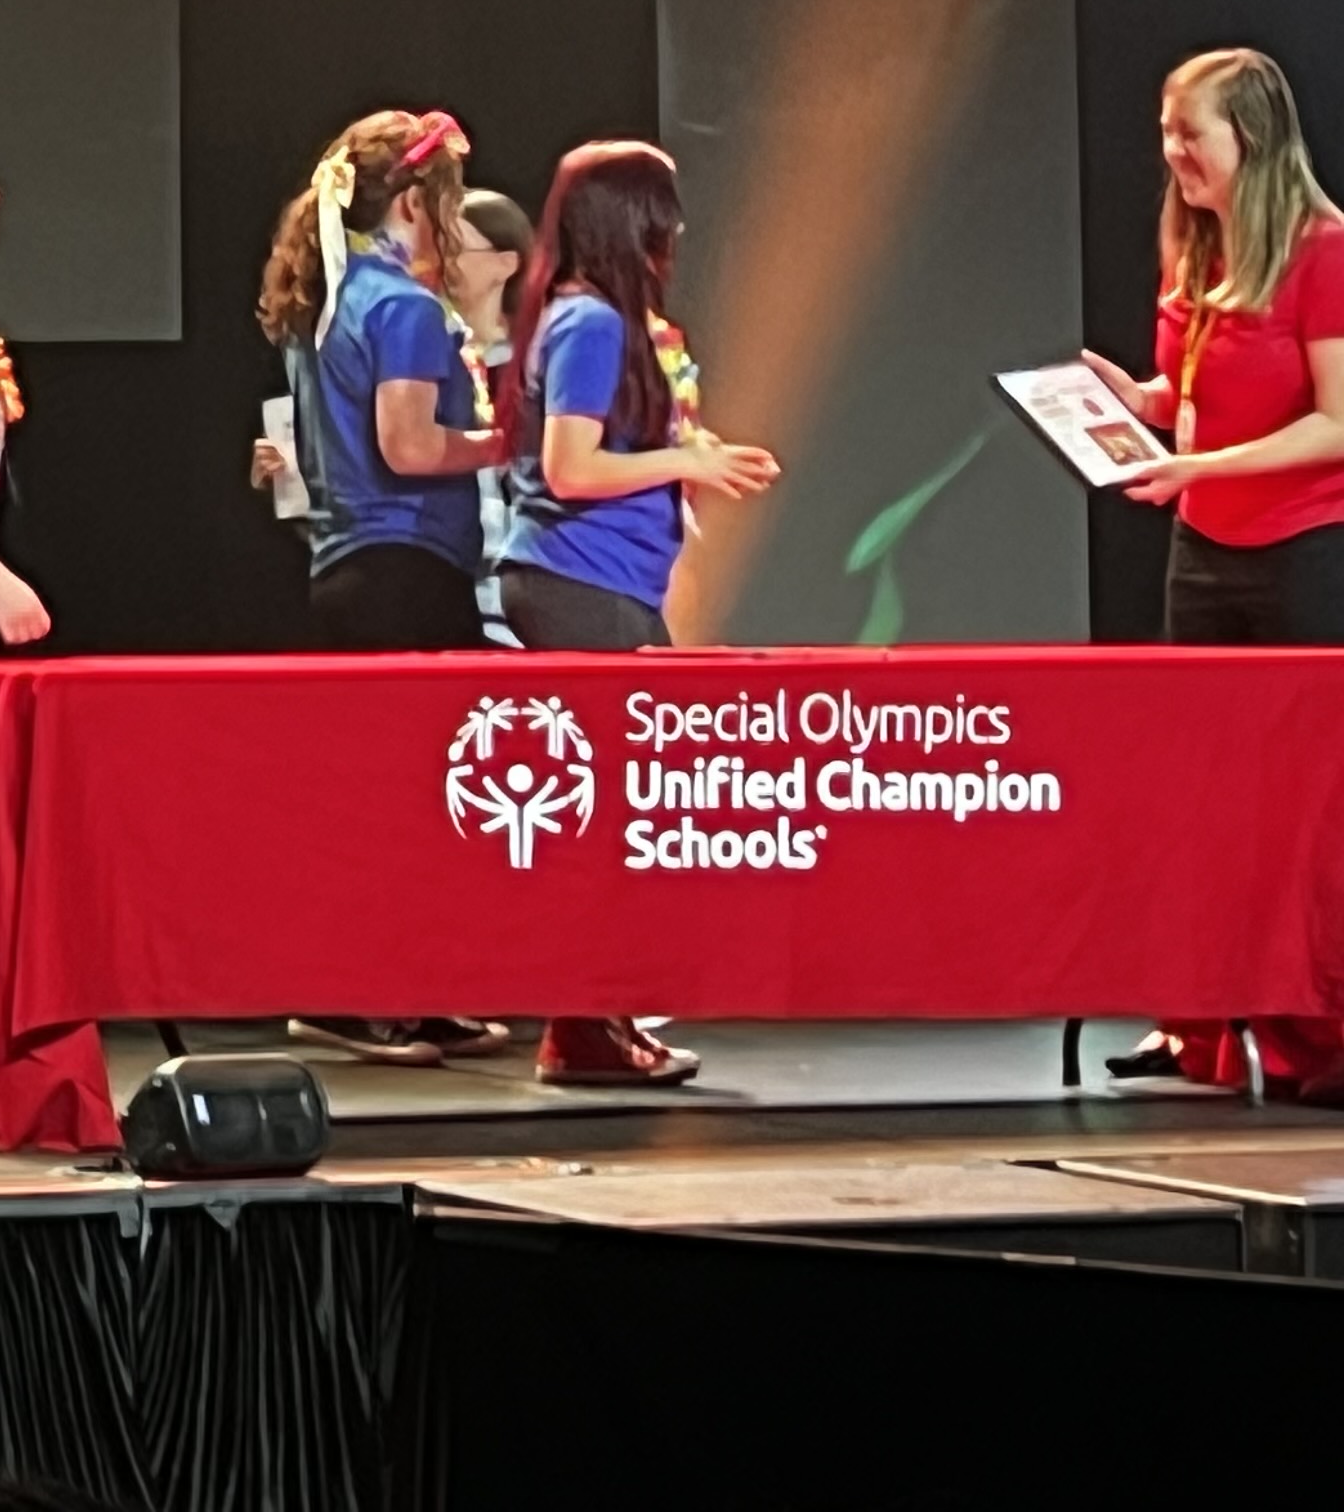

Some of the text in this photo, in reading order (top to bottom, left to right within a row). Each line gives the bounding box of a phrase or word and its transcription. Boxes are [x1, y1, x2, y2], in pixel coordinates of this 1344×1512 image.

[625, 688, 1012, 755] Special Olympics
[625, 756, 1062, 823] Unified Champion
